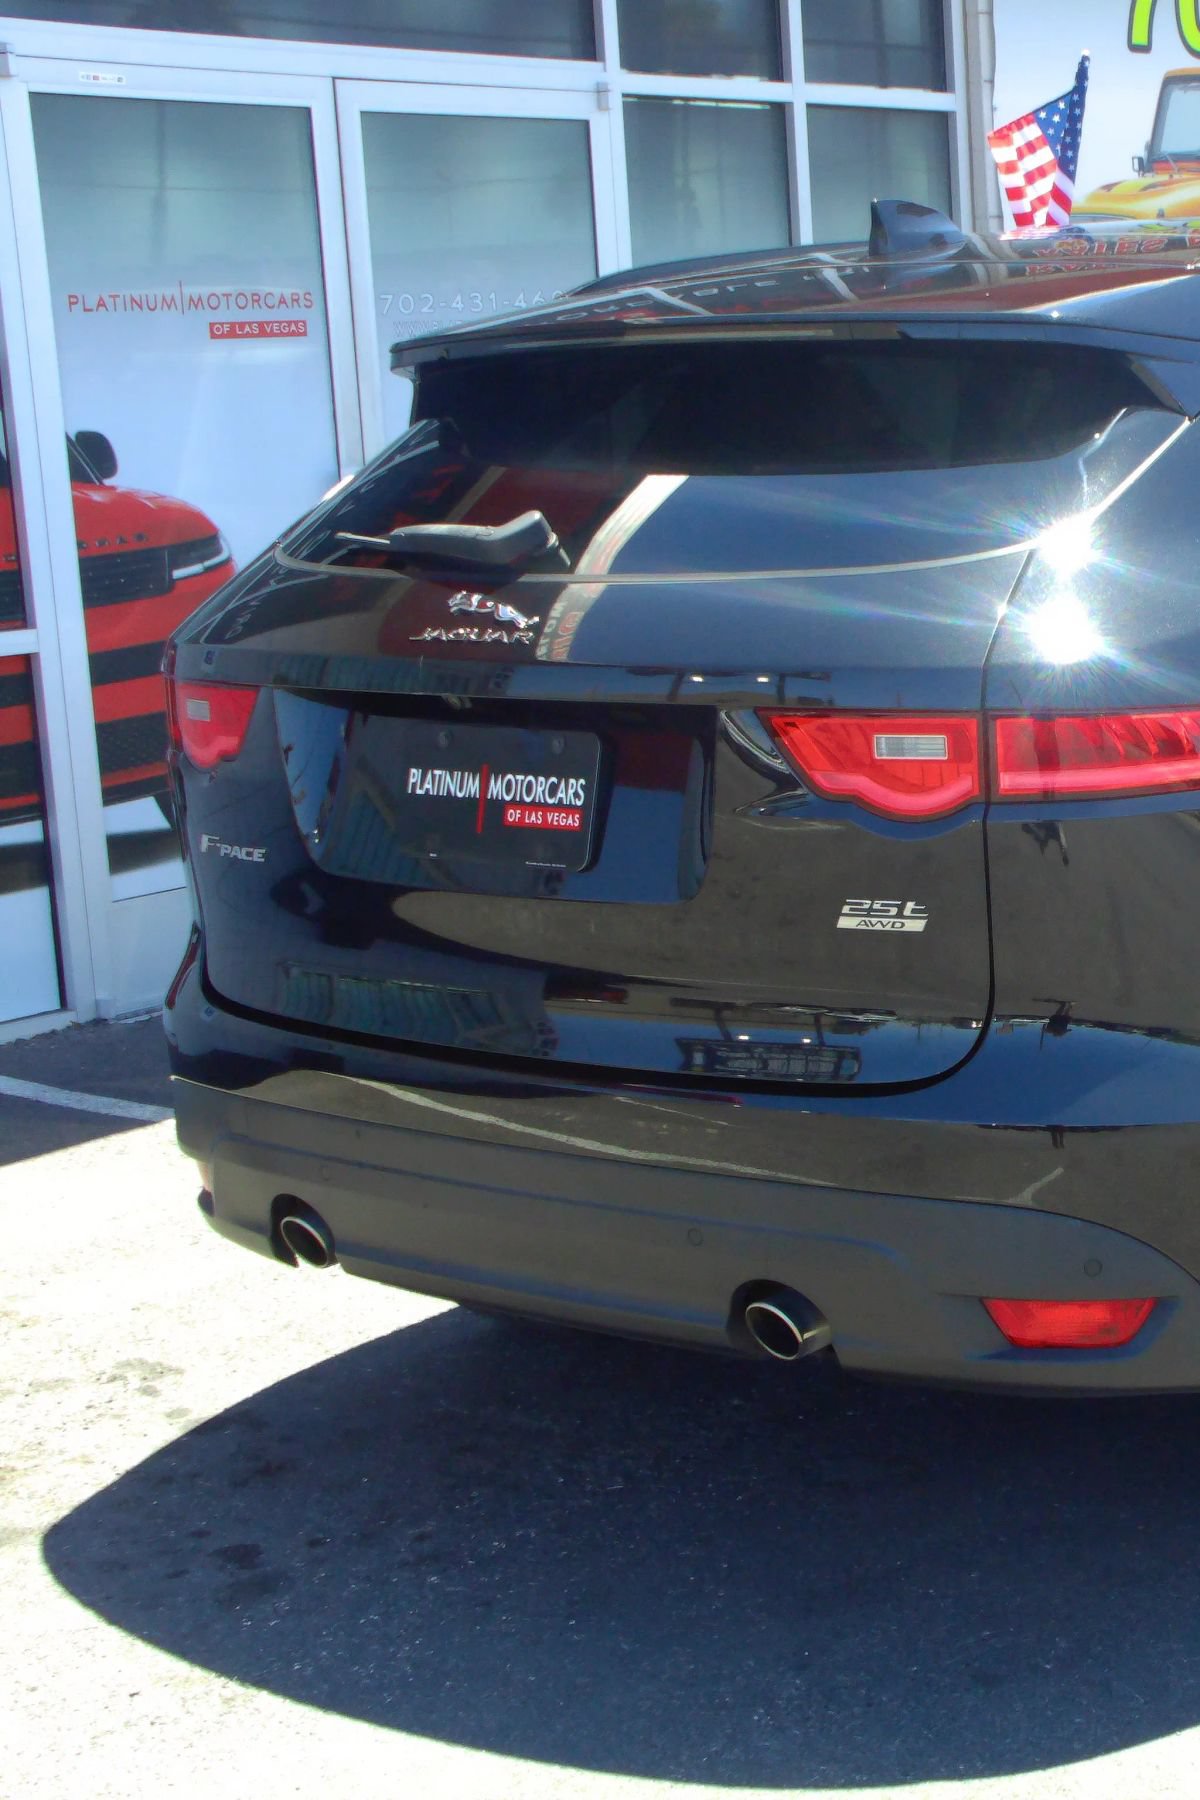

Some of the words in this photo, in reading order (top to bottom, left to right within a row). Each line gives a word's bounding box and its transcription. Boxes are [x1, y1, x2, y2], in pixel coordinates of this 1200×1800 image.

[67, 294, 177, 313] PLATINUM
[188, 291, 315, 311] MOTORCARS
[213, 324, 231, 336] OF
[236, 323, 260, 335] LAS
[264, 322, 306, 334] VEGAS
[409, 627, 535, 645] JAGUAR
[407, 767, 480, 799] PLATINUM
[487, 772, 586, 807] MOTORCARS
[507, 809, 521, 823] OF
[525, 810, 543, 825] LAS
[547, 812, 580, 827] VEGAS
[856, 919, 906, 929] AWD
